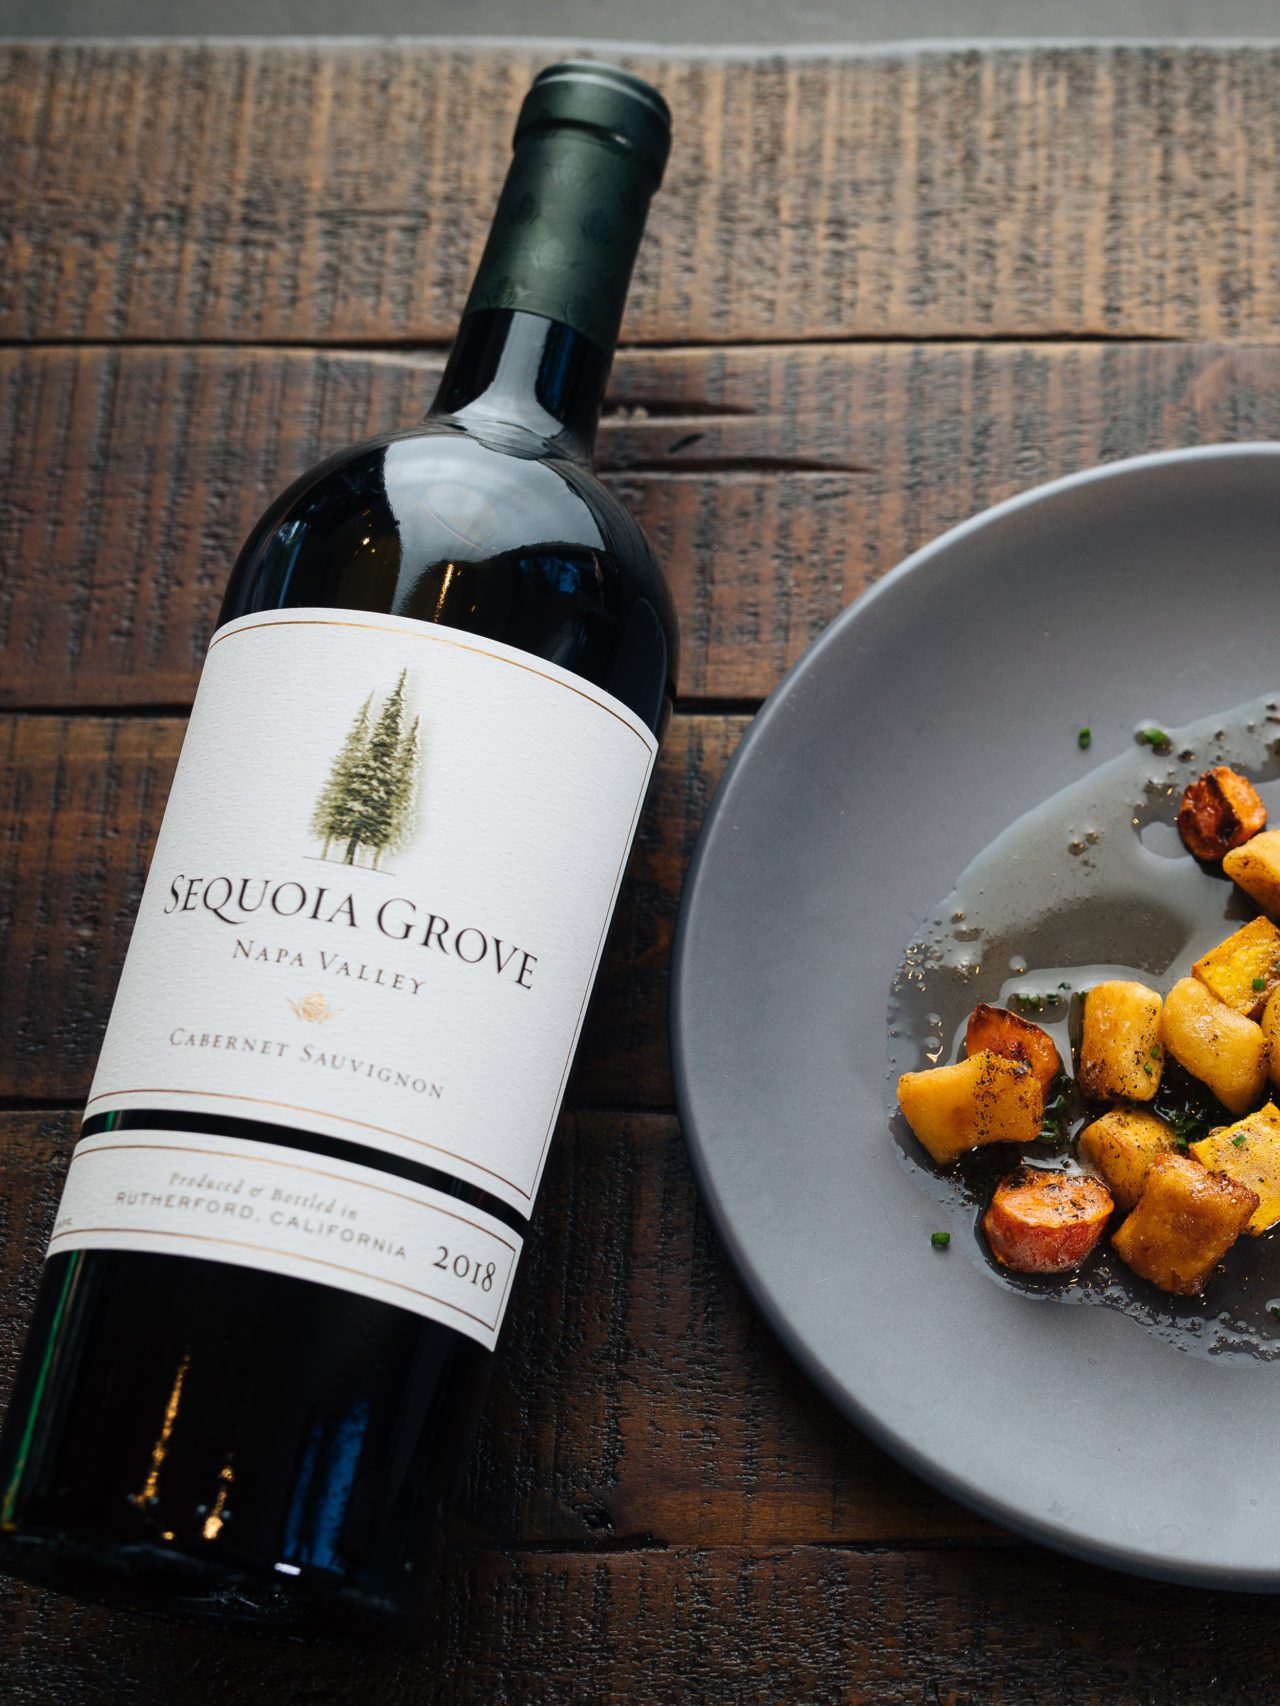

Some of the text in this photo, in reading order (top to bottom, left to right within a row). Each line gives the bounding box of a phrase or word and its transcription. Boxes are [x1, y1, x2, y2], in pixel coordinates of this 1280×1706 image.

[164, 874, 538, 990] SEQUOIA GROVE
[232, 938, 426, 995] NAPA VALLEY
[170, 1028, 444, 1099] CABERNET SAUVIGNON
[115, 1191, 406, 1259] RUTHERFORD, CALIFORNIA
[168, 1172, 358, 1220] Produced & Bottled in
[432, 1246, 496, 1292] 2018
